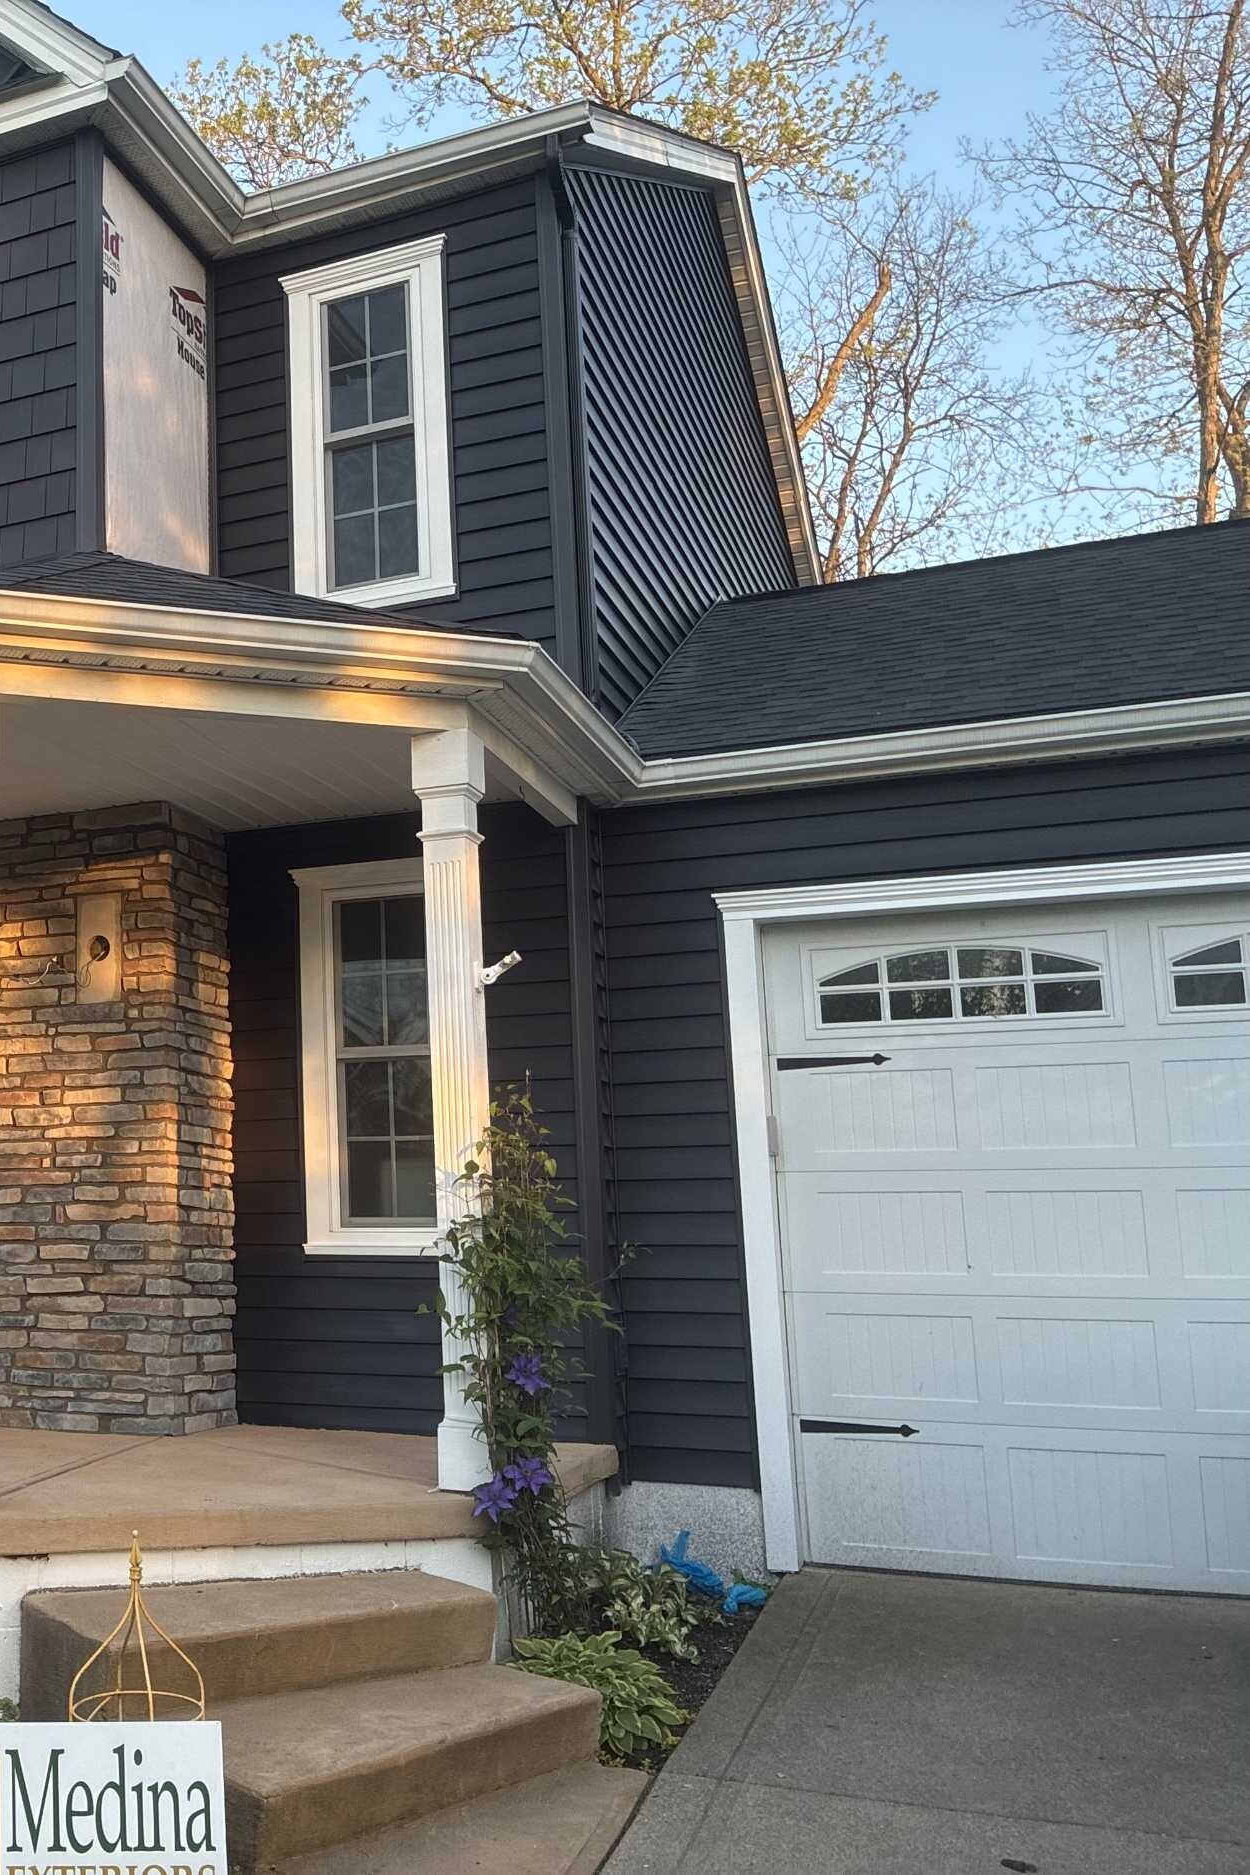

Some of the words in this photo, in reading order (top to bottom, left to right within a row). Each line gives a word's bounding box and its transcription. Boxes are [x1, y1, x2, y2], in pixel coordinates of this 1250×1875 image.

[102, 221, 120, 262] ld
[177, 335, 205, 380] House
[5, 1743, 217, 1855] Medina
